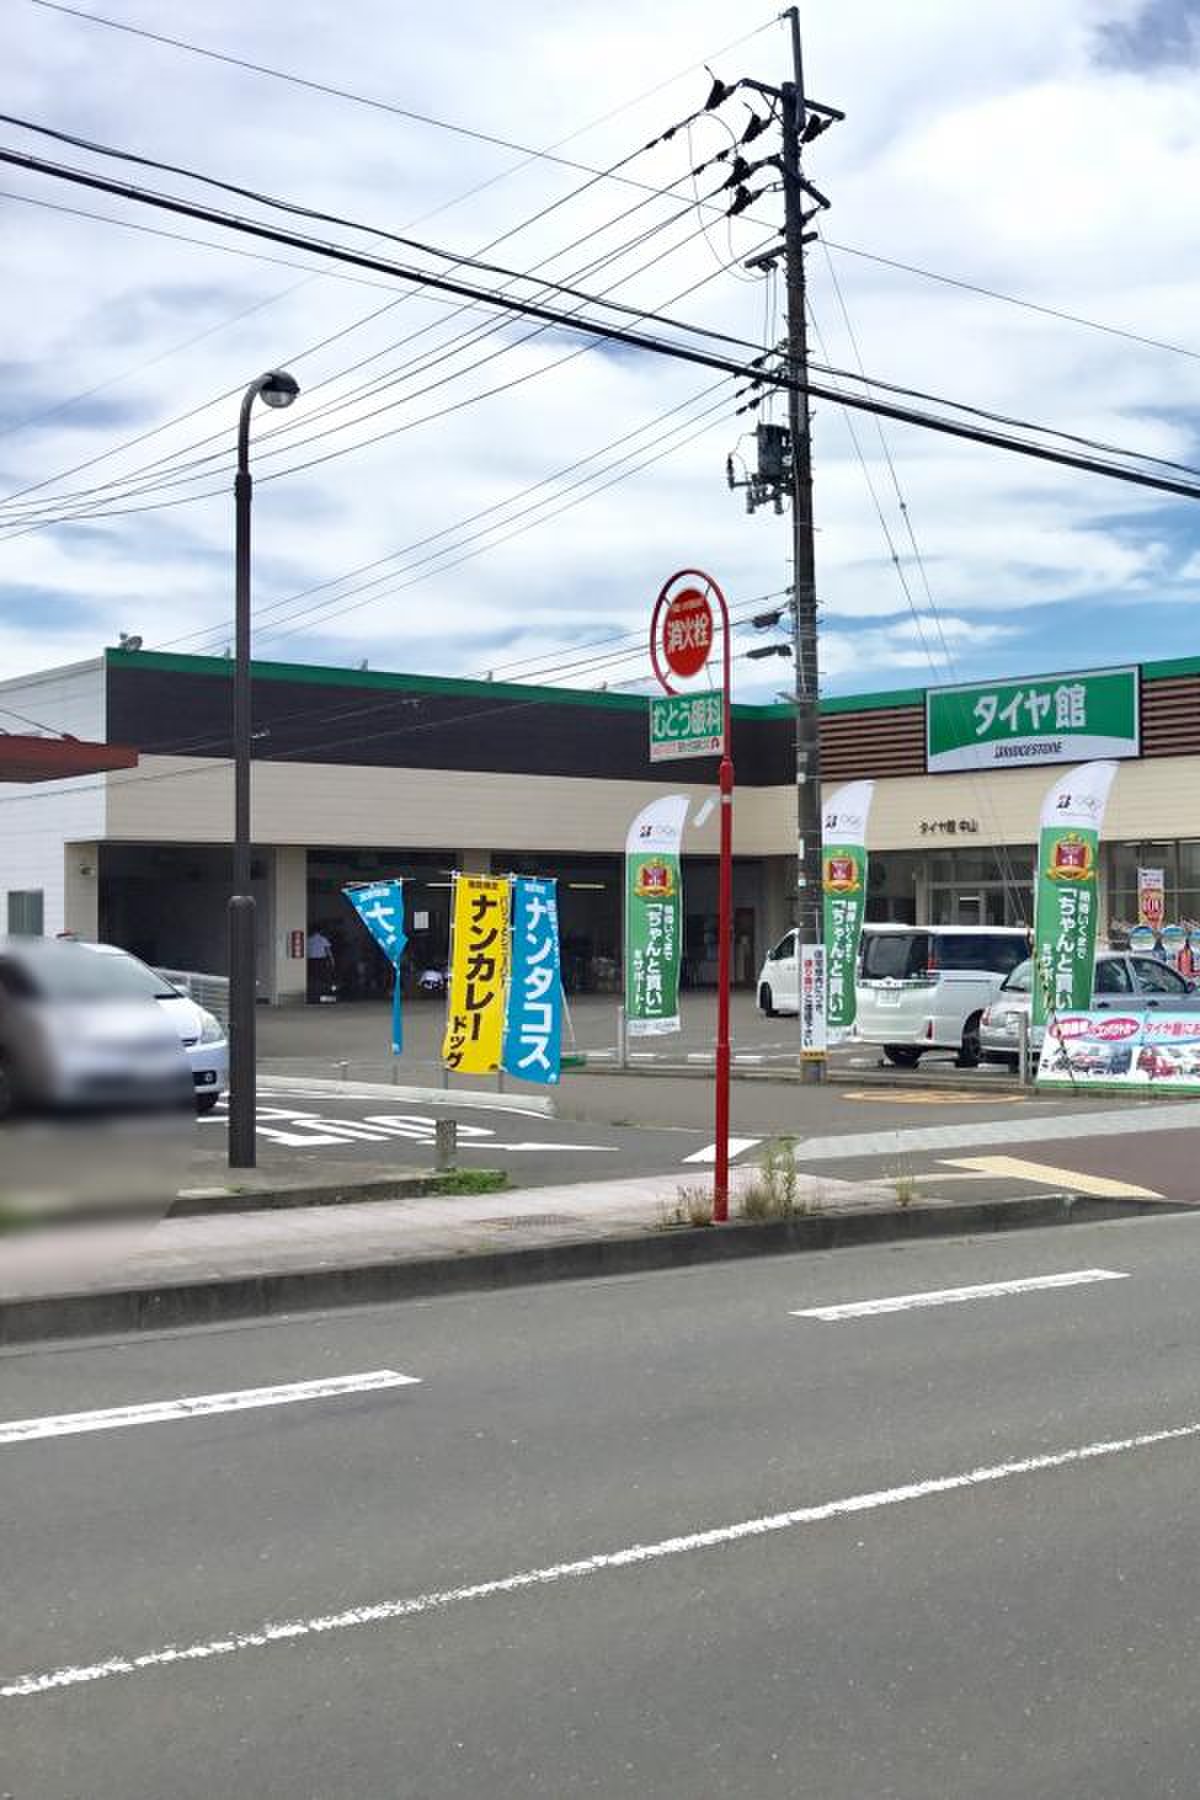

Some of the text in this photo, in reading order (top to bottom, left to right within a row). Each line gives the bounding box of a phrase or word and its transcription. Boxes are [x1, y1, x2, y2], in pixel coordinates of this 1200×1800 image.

[667, 613, 710, 653] 消火栓
[973, 683, 1087, 736] タイヤ館
[465, 895, 498, 1041] ナンカレー
[517, 897, 553, 1070] ナンタコス
[447, 1014, 467, 1069] ドッグ
